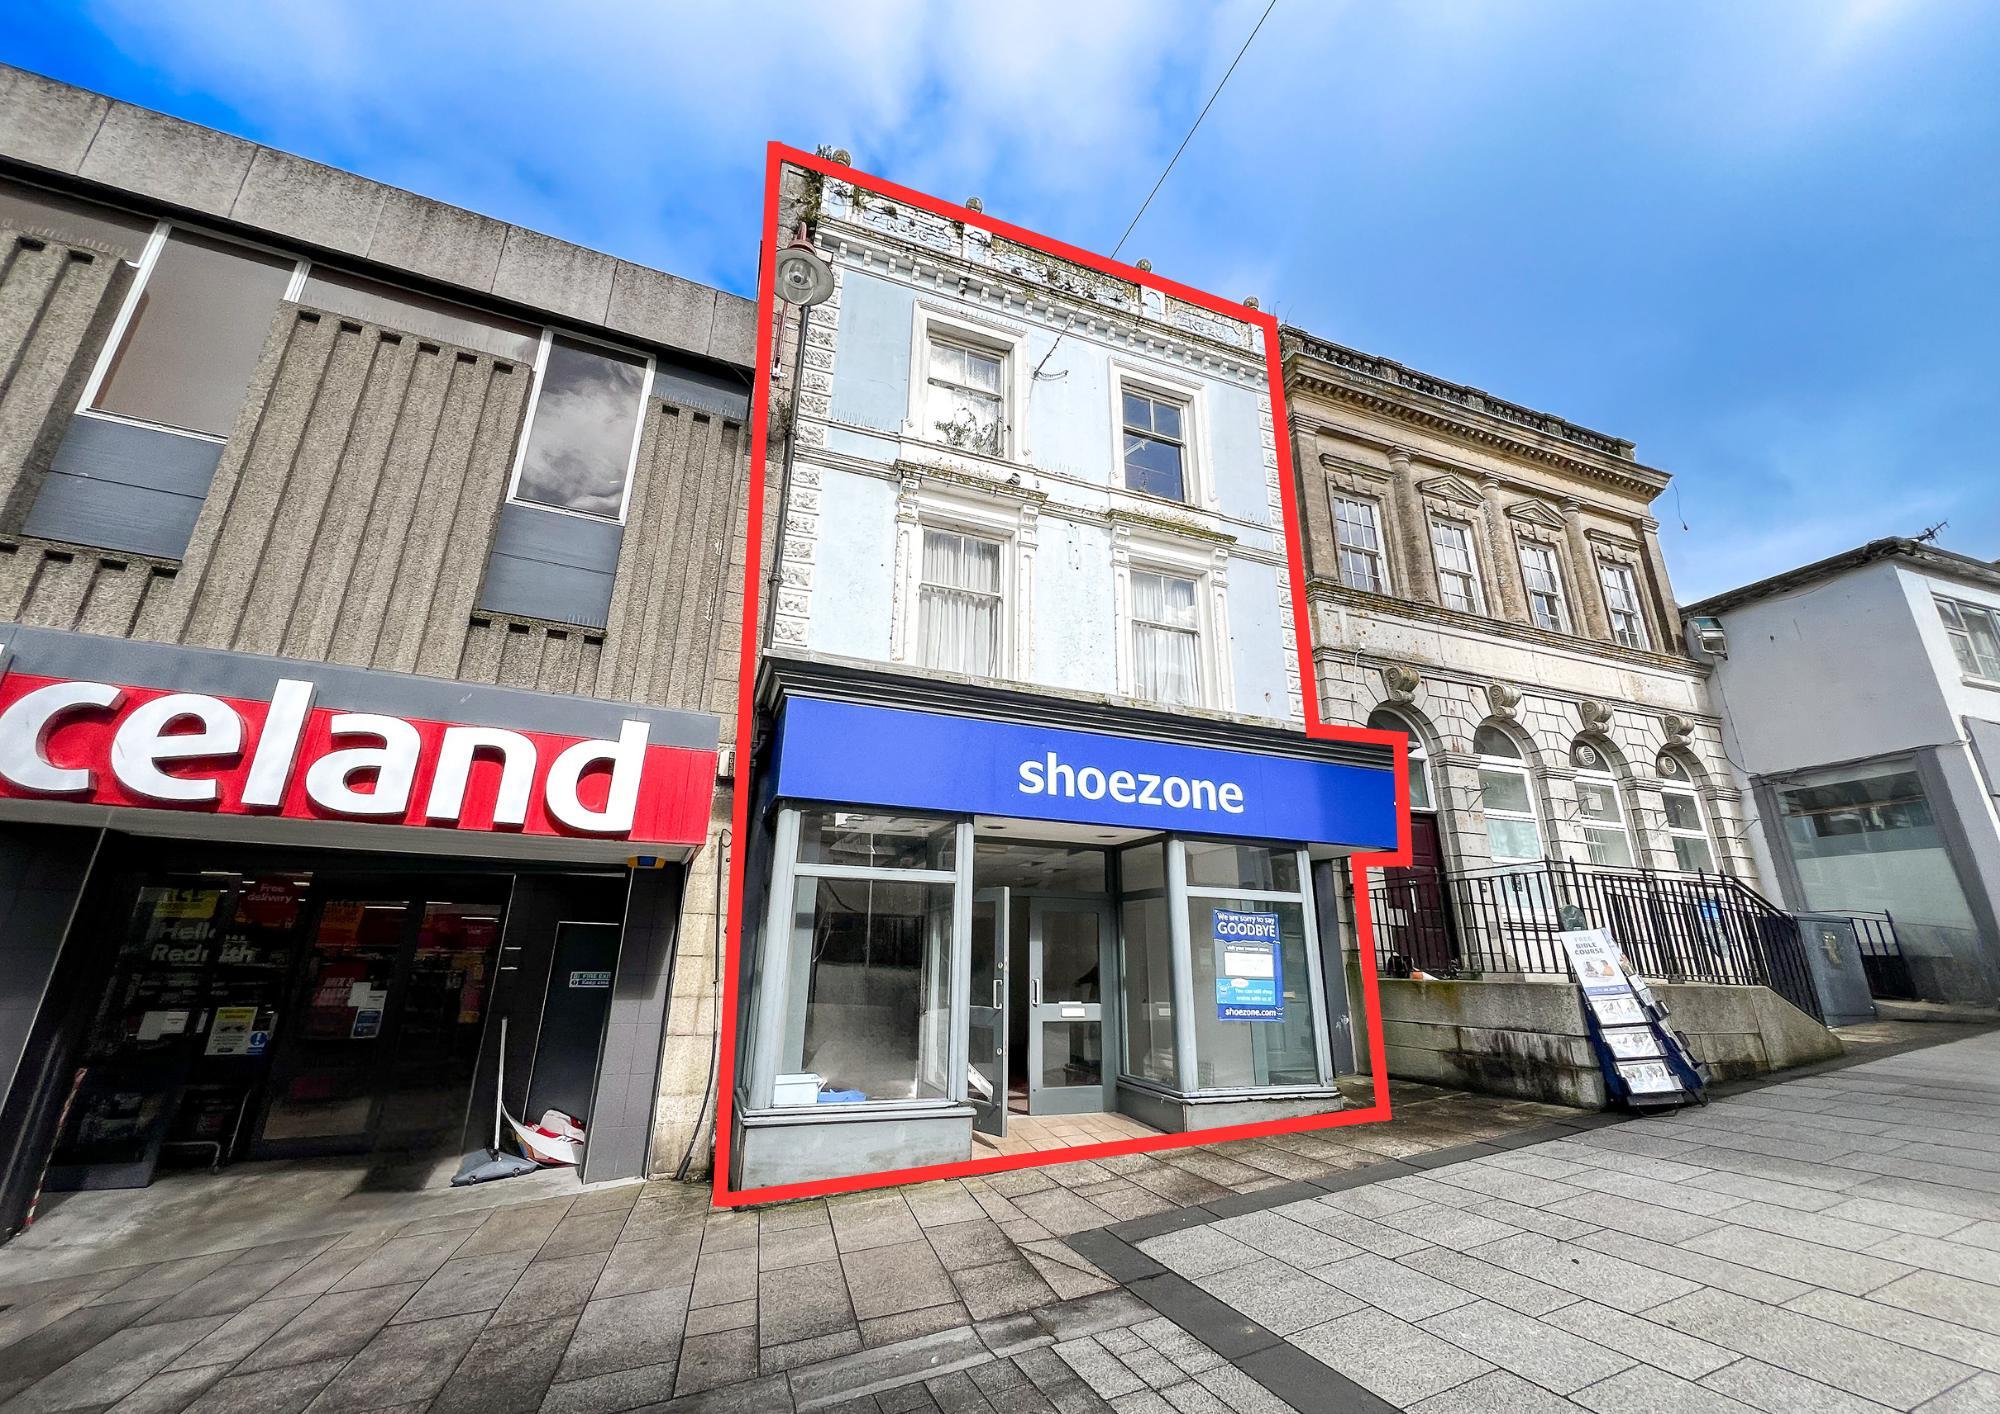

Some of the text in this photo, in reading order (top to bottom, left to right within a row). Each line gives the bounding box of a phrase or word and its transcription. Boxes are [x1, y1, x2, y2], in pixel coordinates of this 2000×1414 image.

[0, 679, 650, 833] celand
[1018, 751, 1244, 814] shoezone
[1217, 912, 1228, 921] We
[1240, 916, 1256, 924] sorry
[1217, 921, 1276, 937] GOODBYE
[1574, 947, 1605, 956] COURSE
[1225, 1007, 1277, 1017] shoezone.com
